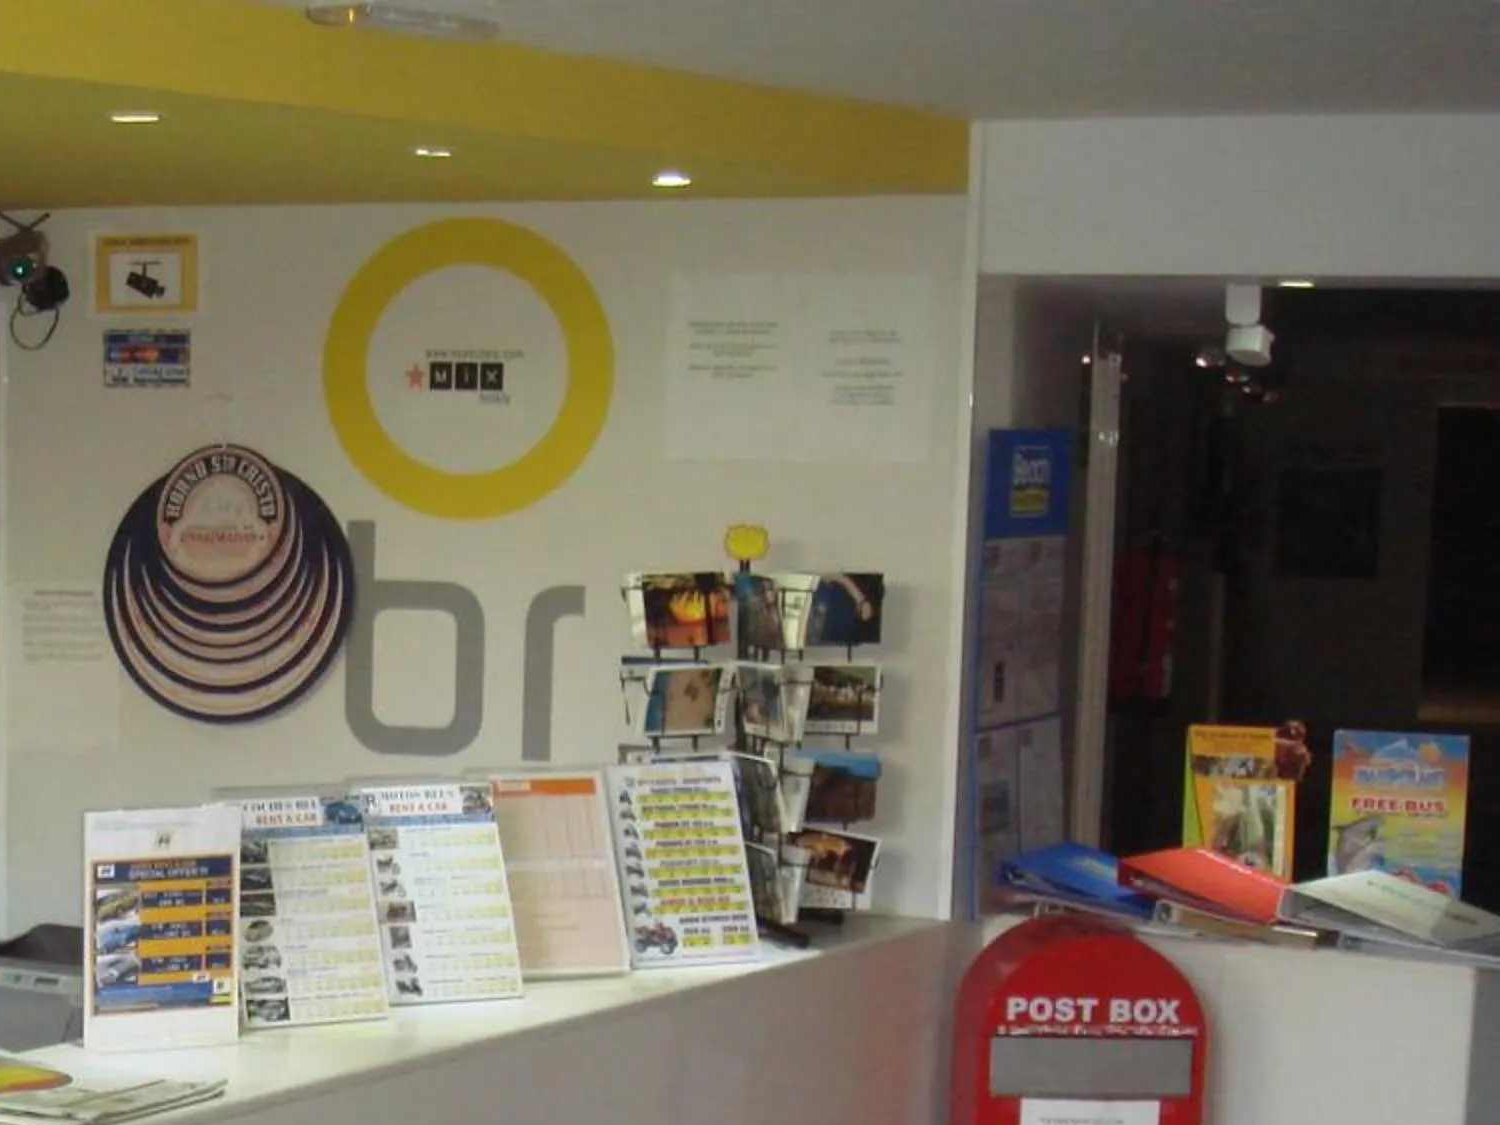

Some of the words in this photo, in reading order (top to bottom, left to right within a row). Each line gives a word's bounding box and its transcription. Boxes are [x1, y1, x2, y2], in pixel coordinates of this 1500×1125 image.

[1352, 797, 1396, 811] FREE
[1405, 799, 1446, 813] BUS
[1007, 997, 1099, 1023] POST
[1109, 998, 1180, 1024] BOX
